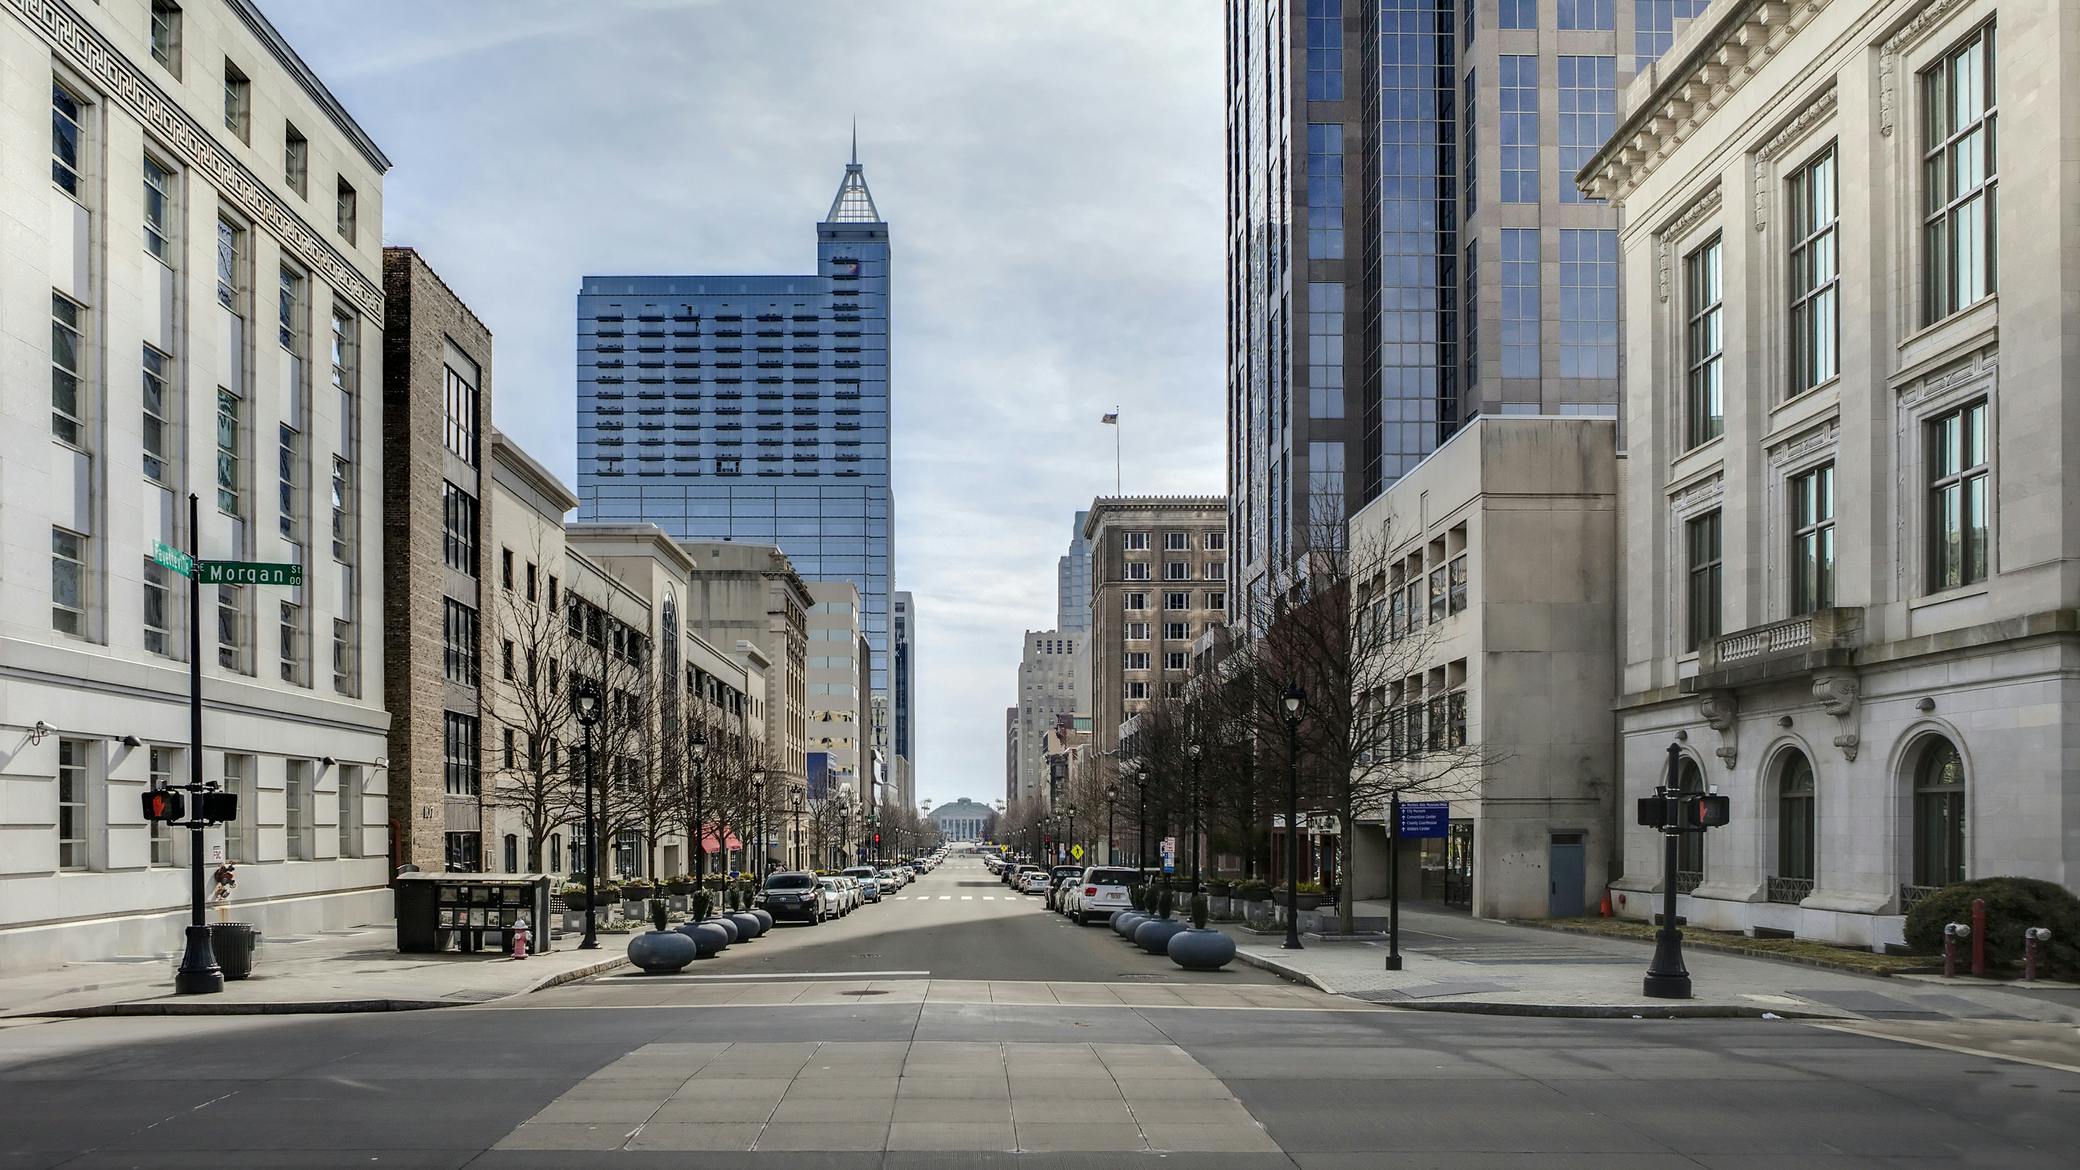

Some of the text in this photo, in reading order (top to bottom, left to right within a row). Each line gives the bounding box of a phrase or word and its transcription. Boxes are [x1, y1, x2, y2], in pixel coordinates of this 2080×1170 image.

[211, 565, 284, 583] Morgan
[291, 565, 302, 574] St
[290, 576, 301, 585] 00
